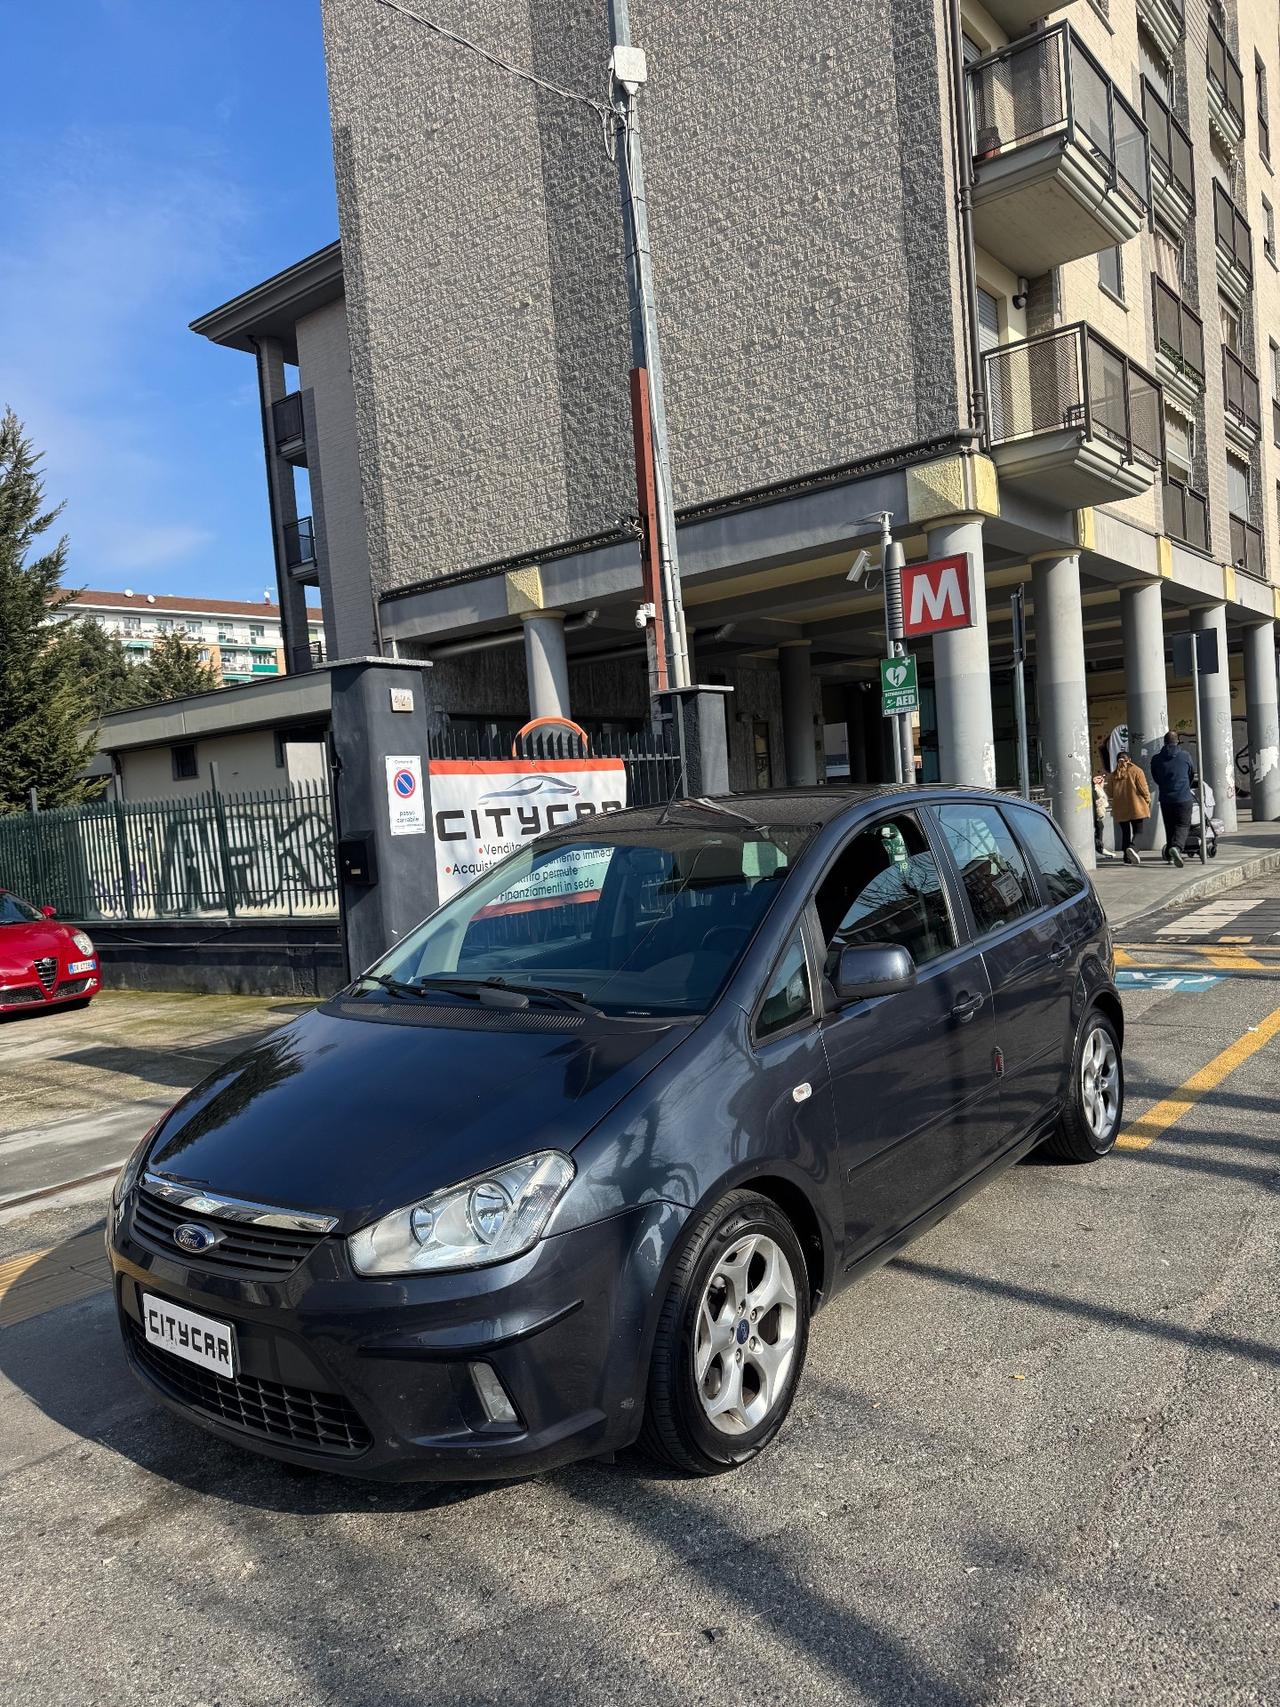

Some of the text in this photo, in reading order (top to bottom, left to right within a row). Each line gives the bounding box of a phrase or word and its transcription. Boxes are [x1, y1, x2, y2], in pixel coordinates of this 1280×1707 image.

[910, 567, 965, 624] M
[896, 694, 915, 707] AED
[543, 866, 579, 881] permute
[500, 878, 595, 900] Finanziamenti in sede
[178, 1228, 200, 1248] Ford
[148, 1308, 230, 1365] CITYCAR
